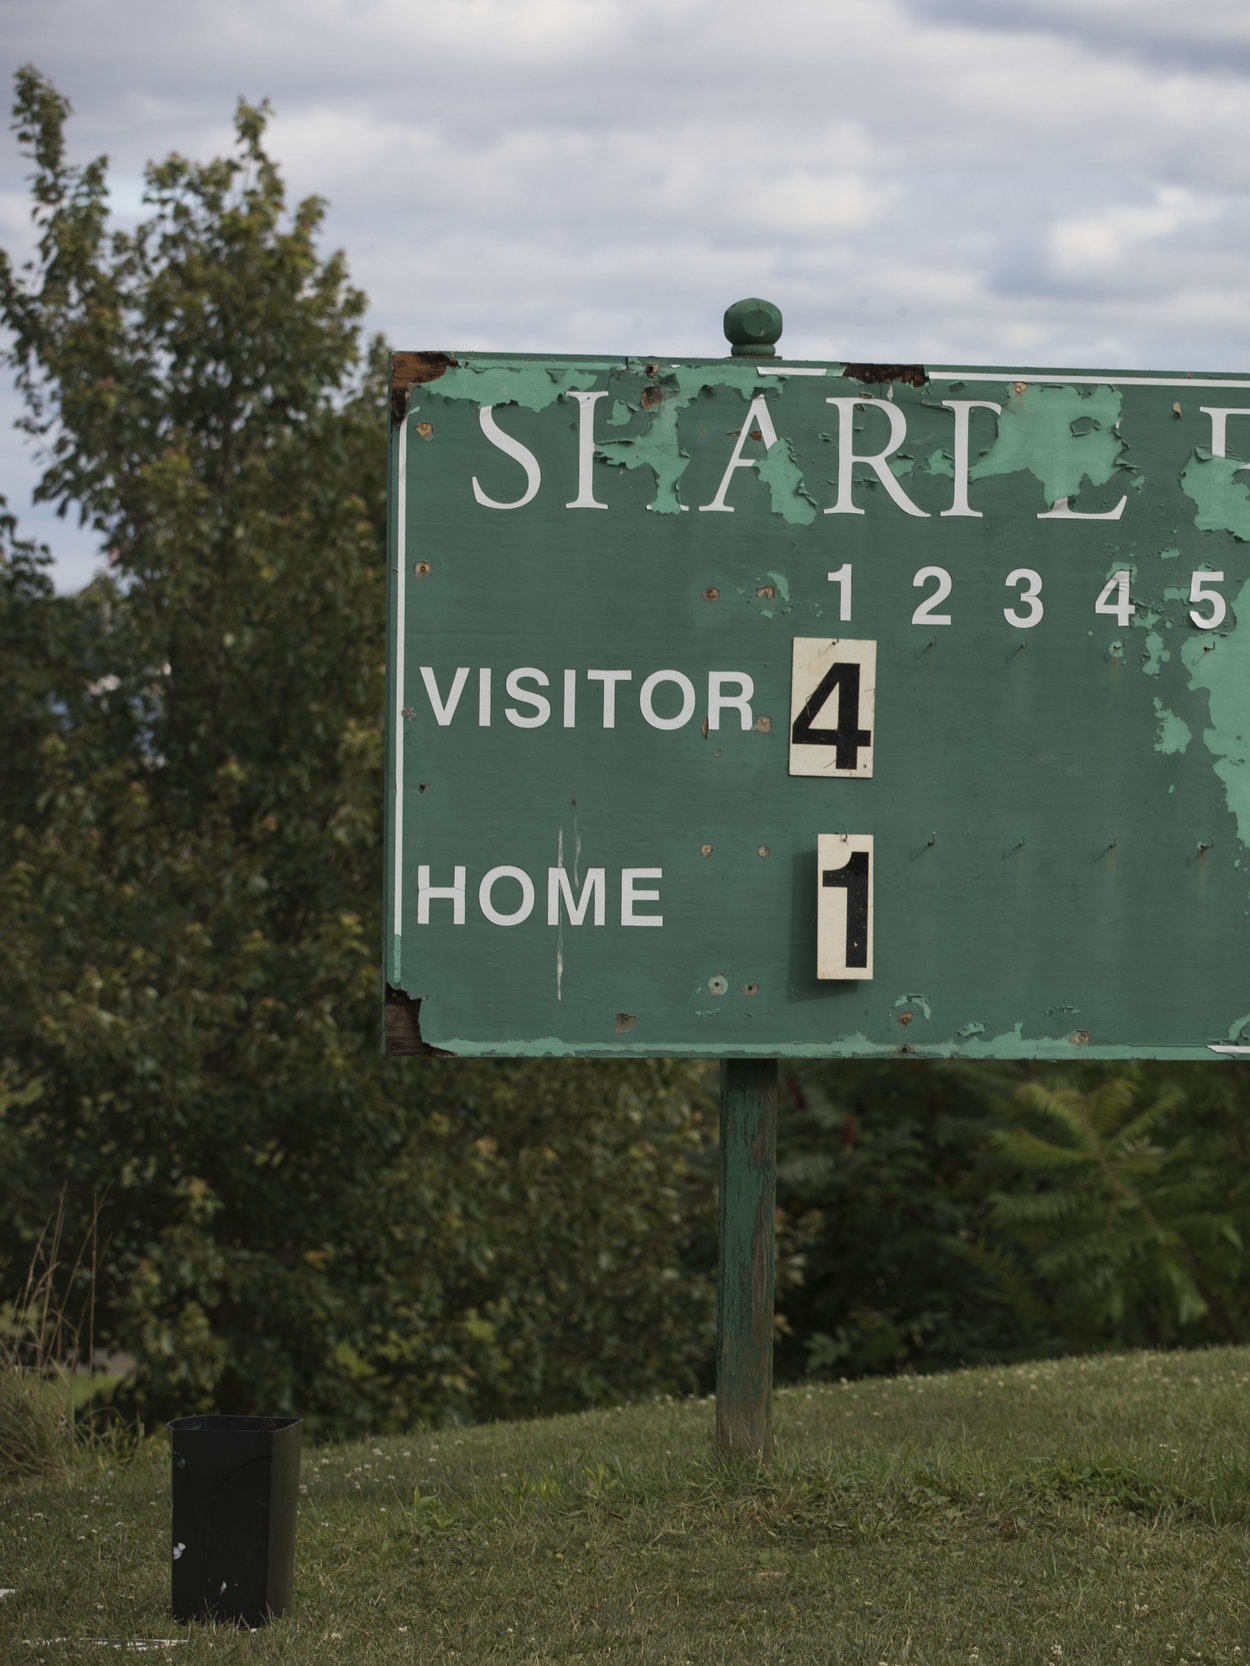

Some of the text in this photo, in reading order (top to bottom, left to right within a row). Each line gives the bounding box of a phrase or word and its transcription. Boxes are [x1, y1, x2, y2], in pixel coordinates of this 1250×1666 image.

[827, 563, 852, 621] 1
[911, 566, 952, 625] 2
[1003, 568, 1044, 628] 3
[1095, 570, 1136, 627] 4
[1189, 571, 1227, 629] 5
[419, 666, 754, 731] VISITOR
[792, 662, 871, 770] 4
[417, 865, 664, 927] HOME
[822, 851, 869, 968] 1
